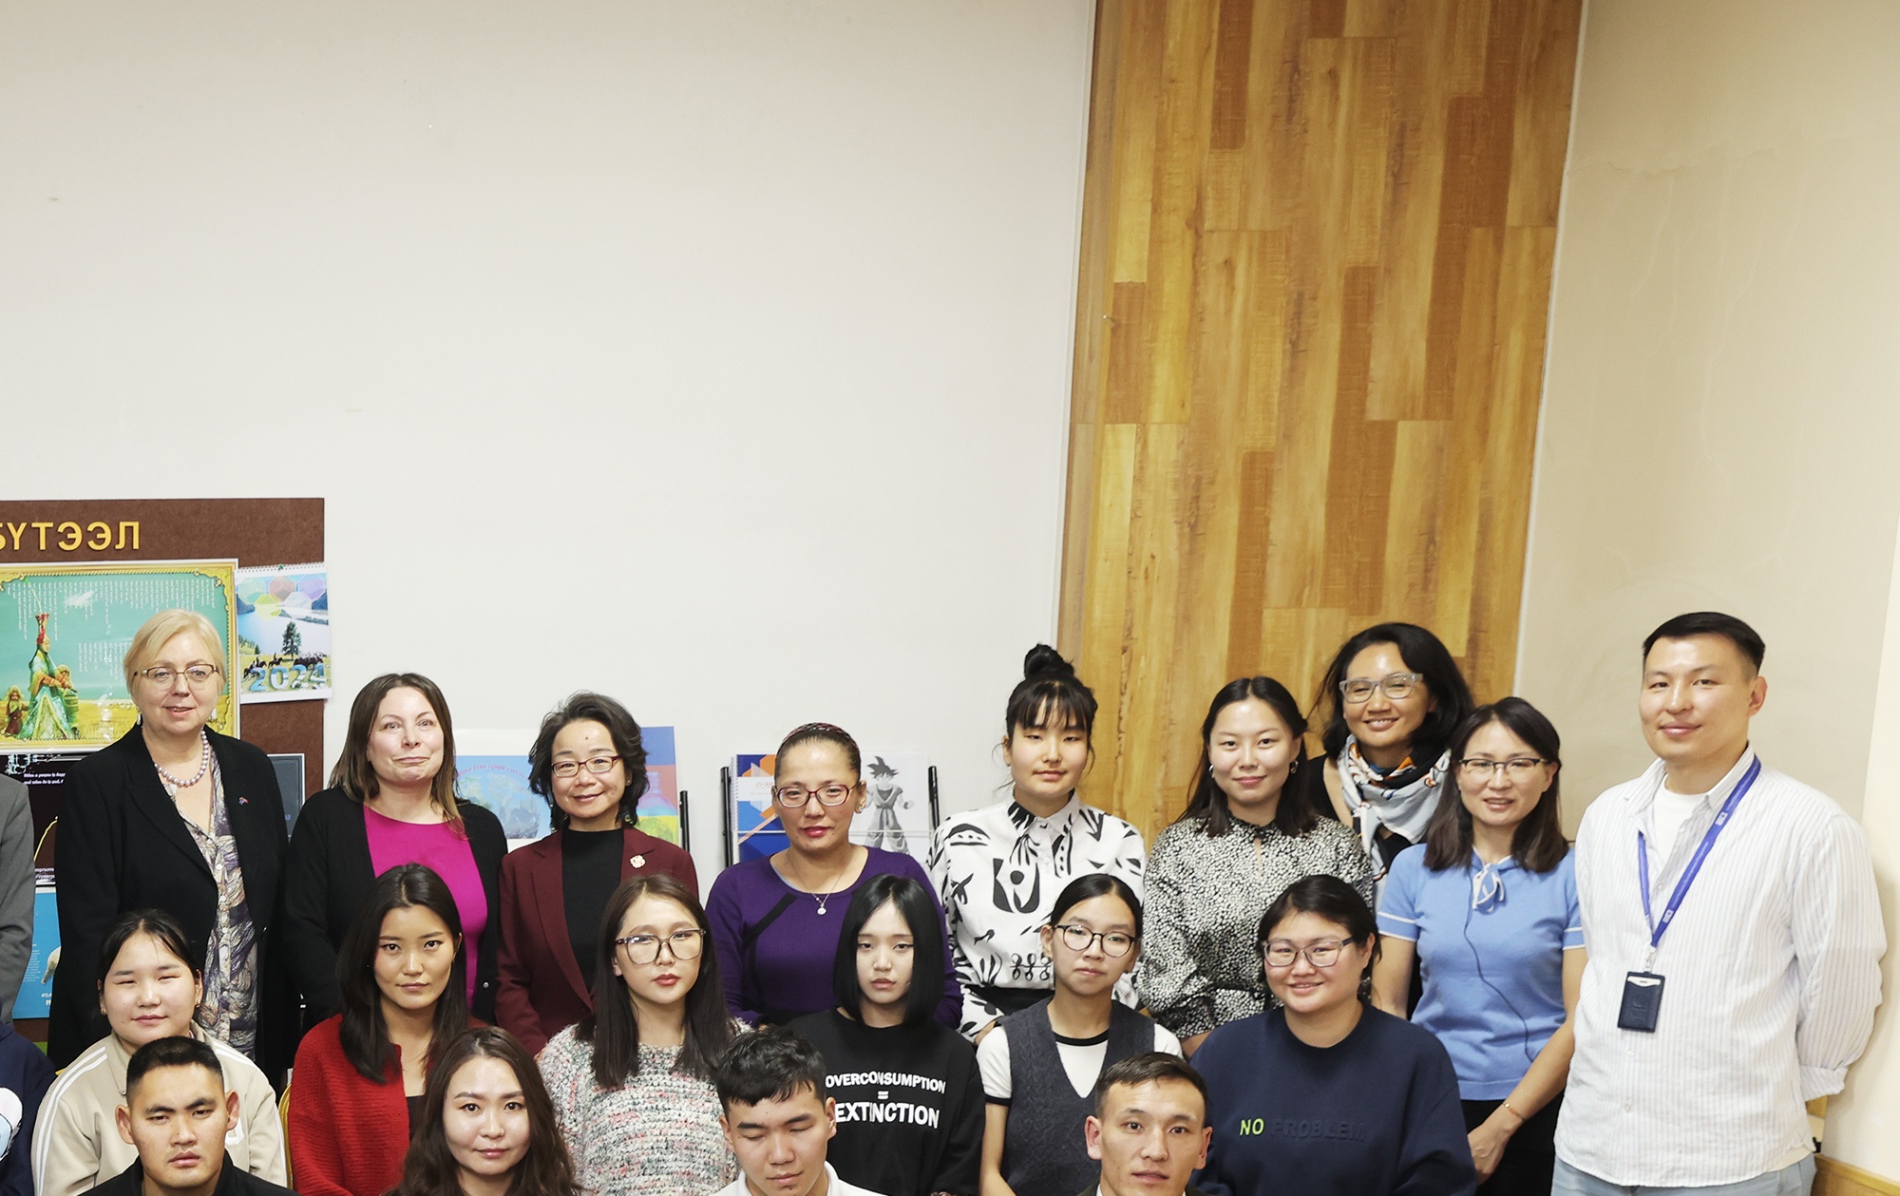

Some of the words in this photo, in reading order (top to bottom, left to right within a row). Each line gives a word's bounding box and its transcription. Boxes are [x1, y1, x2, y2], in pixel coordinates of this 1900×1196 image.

[249, 662, 327, 692] 2024
[825, 1071, 946, 1095] OVERCONSUMPTION
[834, 1102, 940, 1129] EXTINCTION
[1239, 1117, 1265, 1136] NO
